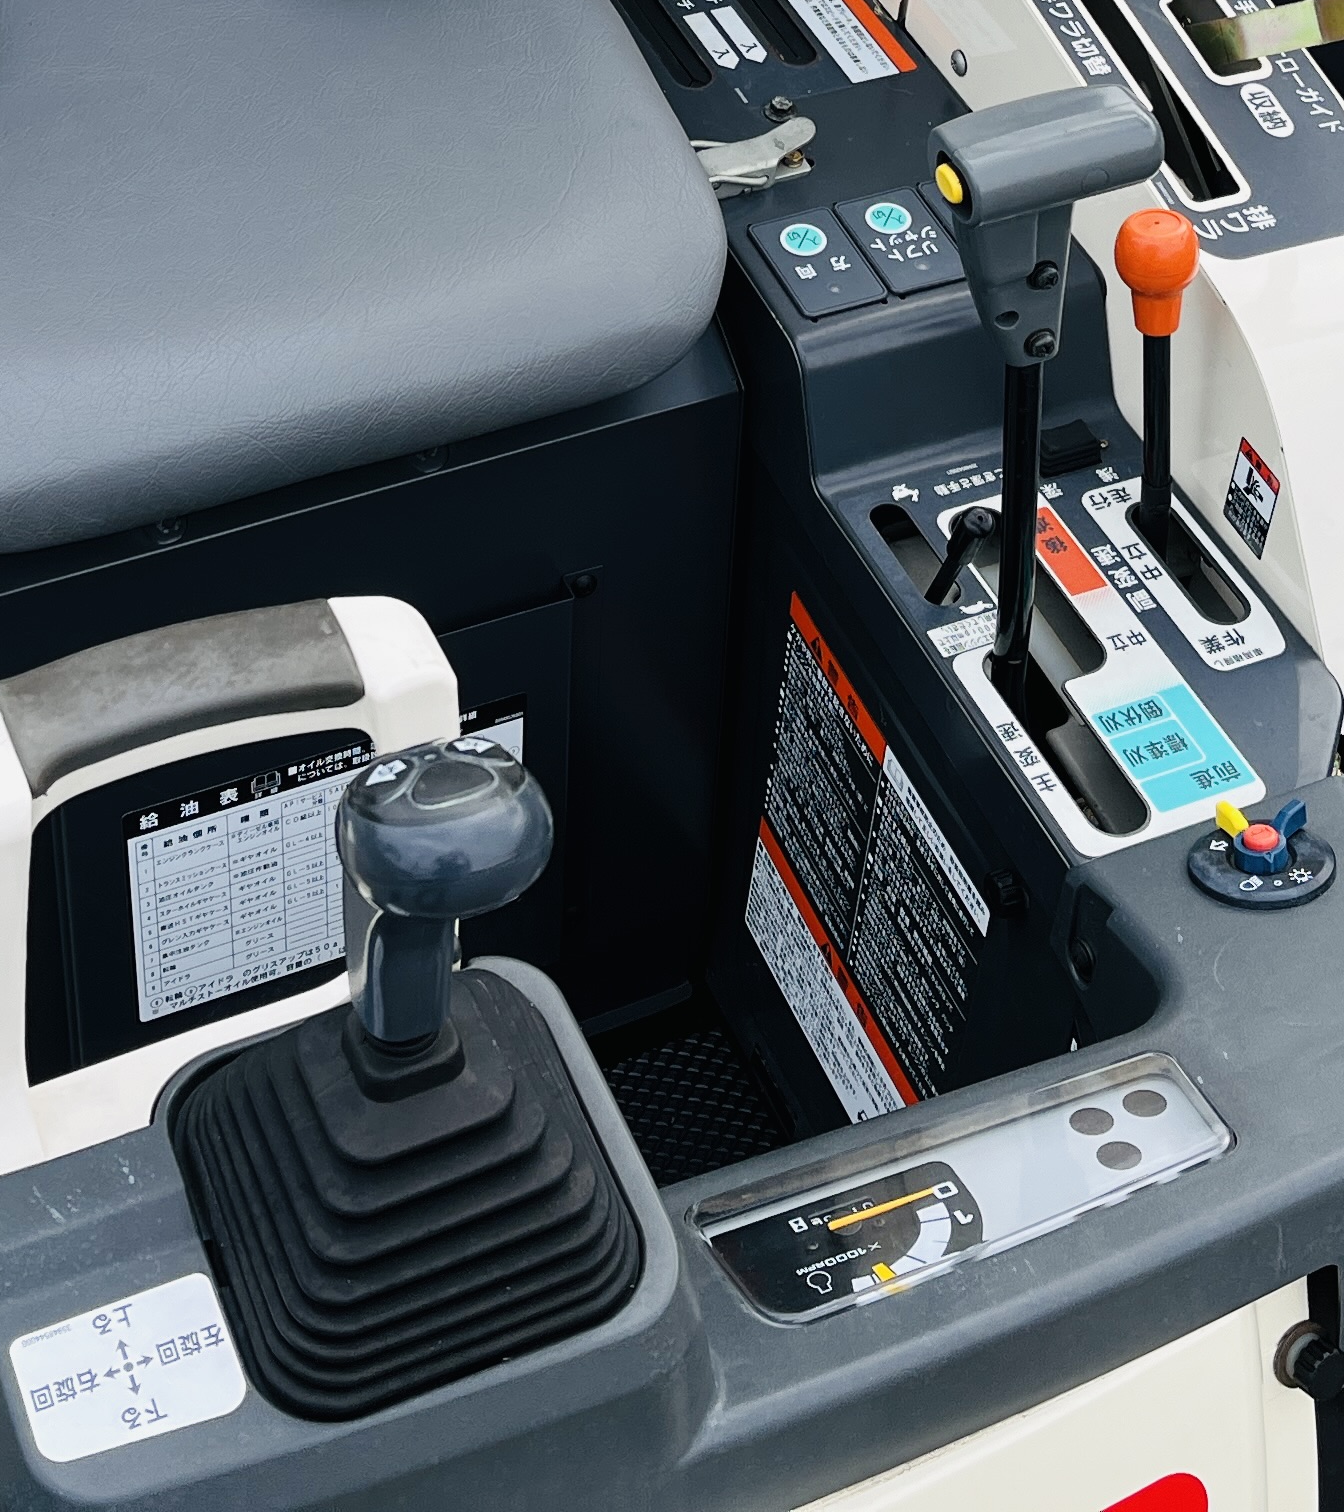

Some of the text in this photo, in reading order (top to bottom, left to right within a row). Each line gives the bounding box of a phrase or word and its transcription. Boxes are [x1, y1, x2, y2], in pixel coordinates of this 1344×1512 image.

[1245, 88, 1290, 132] 収納
[1200, 205, 1276, 241] 排ワラ
[794, 255, 852, 280] 方向
[888, 240, 939, 263] リフト
[1088, 486, 1133, 511] 走行
[1090, 543, 1157, 614] 副変速
[1121, 542, 1164, 582] 中立
[1106, 629, 1147, 652] 中立
[1198, 627, 1246, 655] 作業
[1098, 698, 1164, 734] 倒伏刈
[995, 721, 1058, 793] 主変速
[1122, 732, 1189, 768] 標準刈
[1189, 760, 1242, 790] 前進
[138, 786, 238, 831] 給油表
[933, 1180, 959, 1200] 0
[92, 1303, 134, 1335] 上る
[155, 1323, 226, 1367] 左旋回
[30, 1368, 101, 1414] 右旋回
[120, 1398, 169, 1431] 下る
